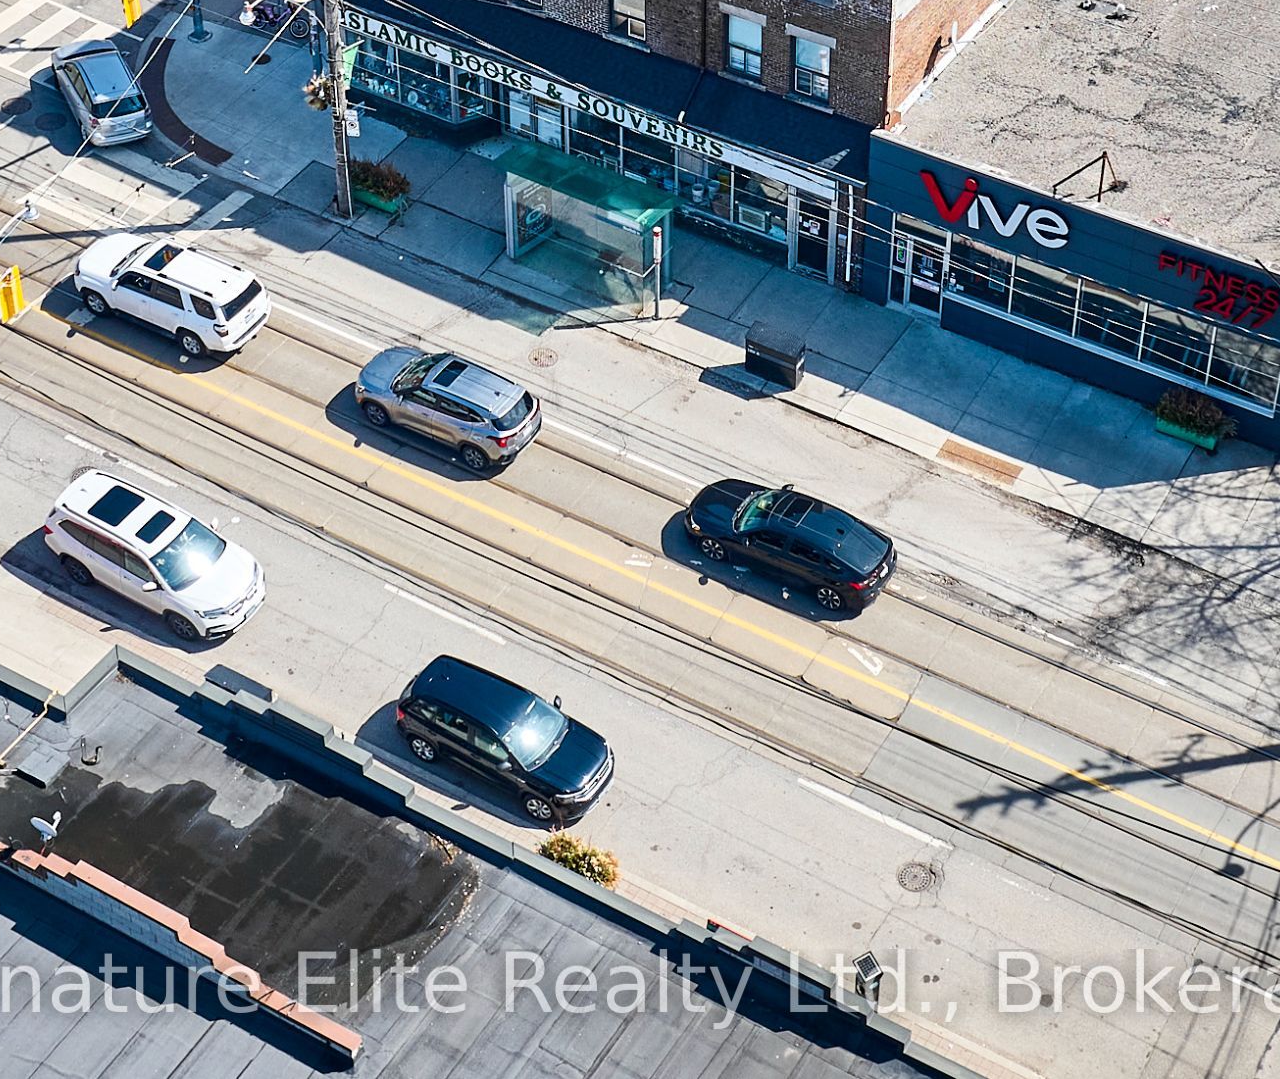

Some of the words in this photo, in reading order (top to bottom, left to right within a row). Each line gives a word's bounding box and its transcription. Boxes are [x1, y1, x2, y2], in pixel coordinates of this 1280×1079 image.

[338, 4, 439, 58] ISLAMIC
[450, 47, 533, 91] BOOKS
[546, 82, 562, 100] &
[577, 92, 724, 158] SOUVENIRS
[1158, 253, 1280, 311] FITNESS
[1194, 288, 1275, 330] 24/7
